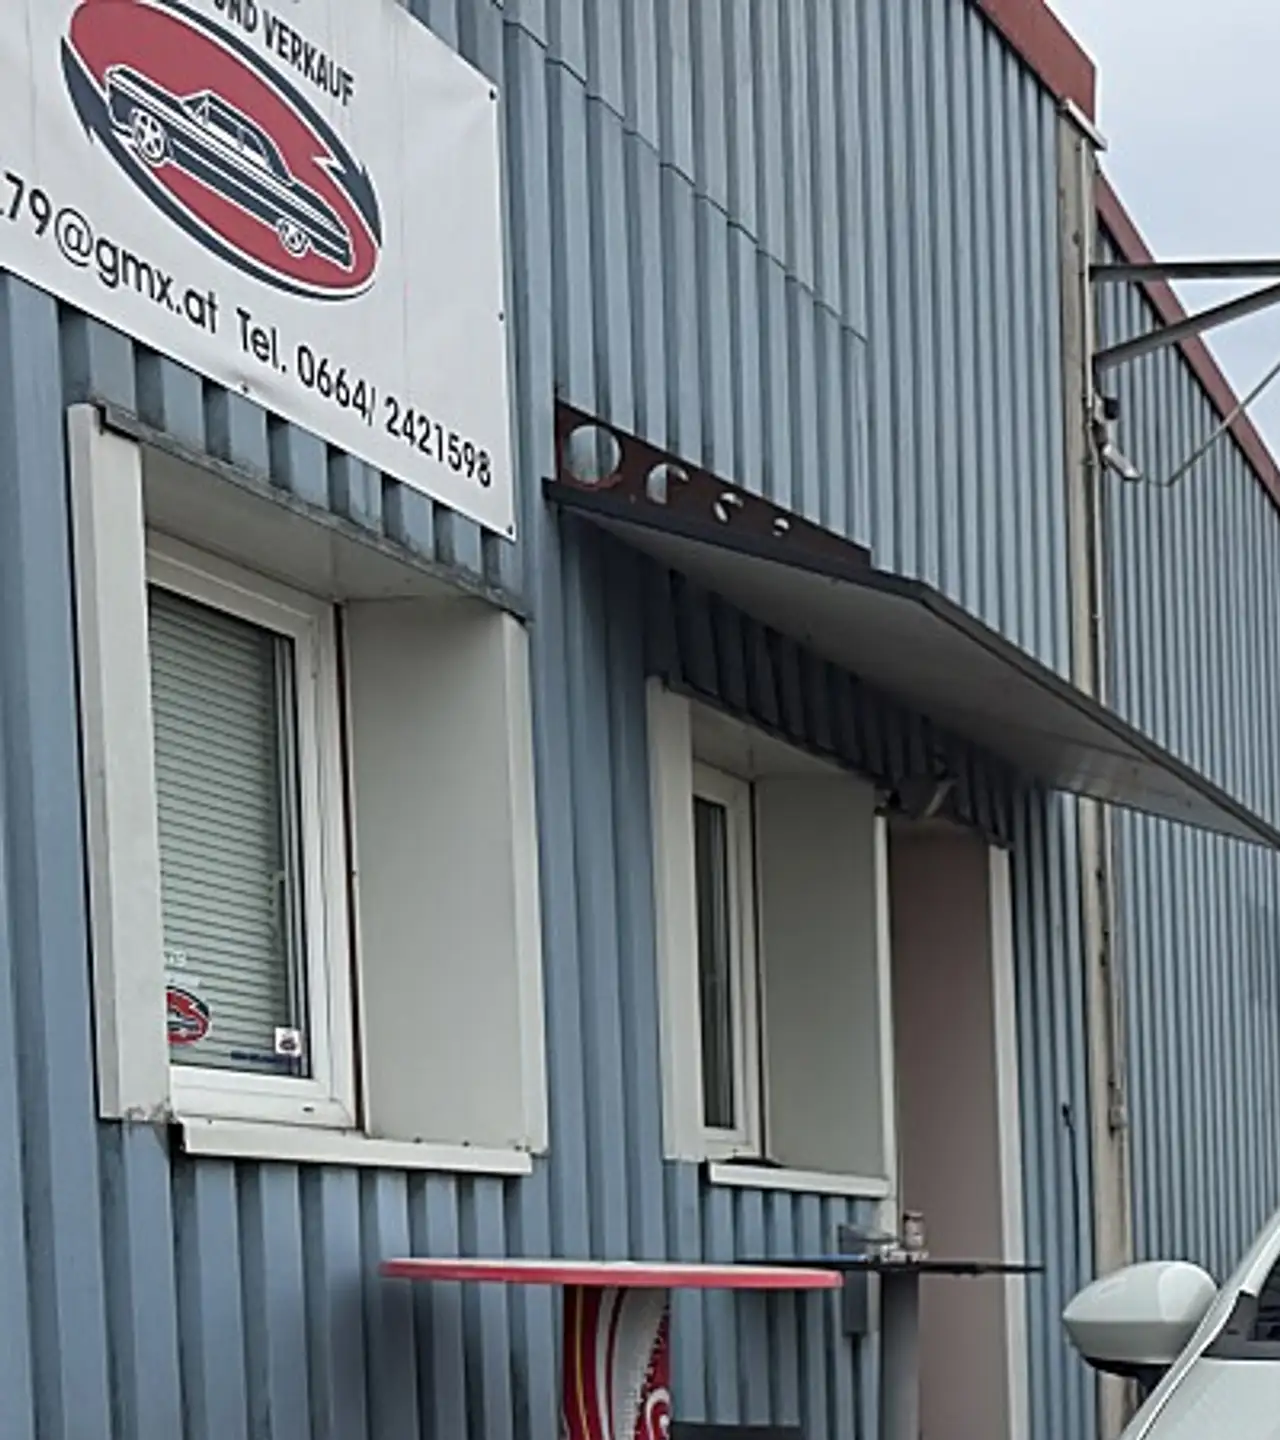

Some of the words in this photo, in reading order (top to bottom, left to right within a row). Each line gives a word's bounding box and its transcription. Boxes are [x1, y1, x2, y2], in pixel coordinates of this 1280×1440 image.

[263, 9, 354, 106] VERKAUF
[0, 172, 217, 333] 79@gmx.at
[236, 307, 288, 373] Tel.
[384, 396, 491, 487] 2421598
